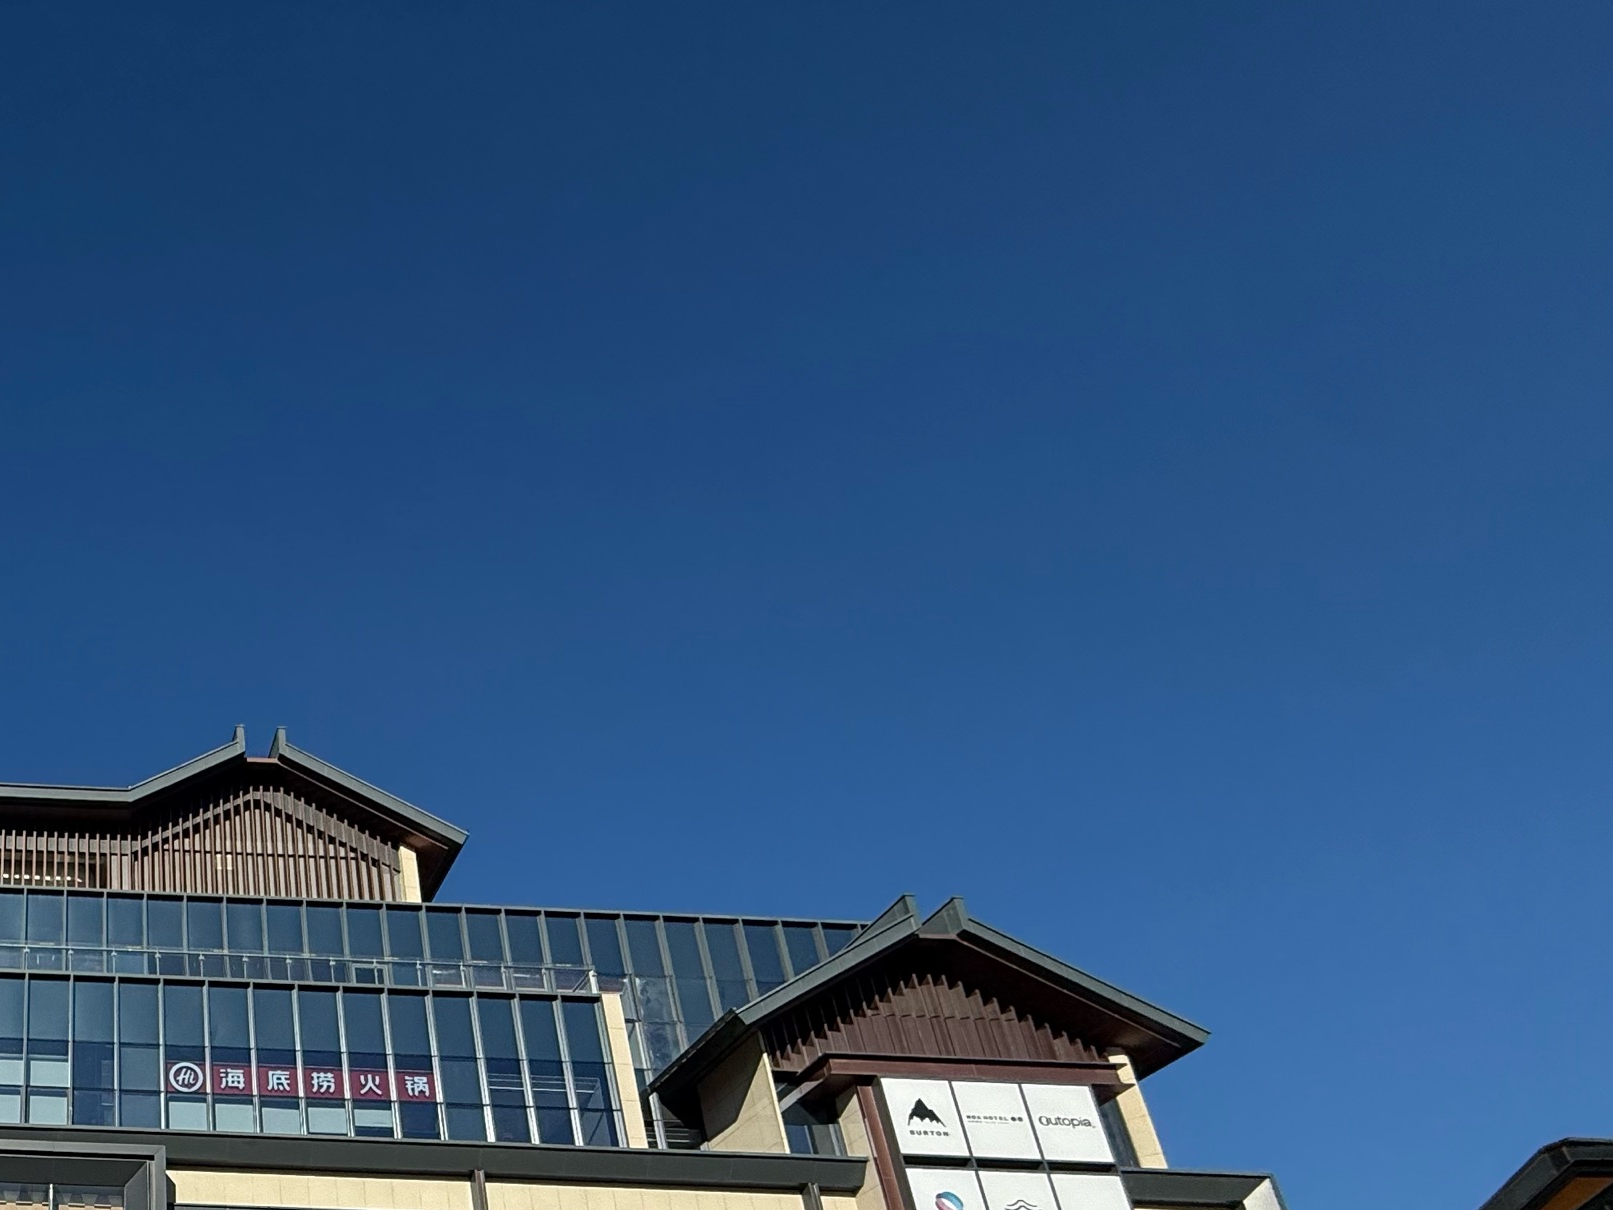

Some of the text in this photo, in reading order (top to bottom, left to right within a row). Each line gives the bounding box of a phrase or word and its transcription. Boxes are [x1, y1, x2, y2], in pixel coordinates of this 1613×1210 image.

[219, 1067, 430, 1097] 海底捞火锅
[909, 1129, 950, 1137] BURTON
